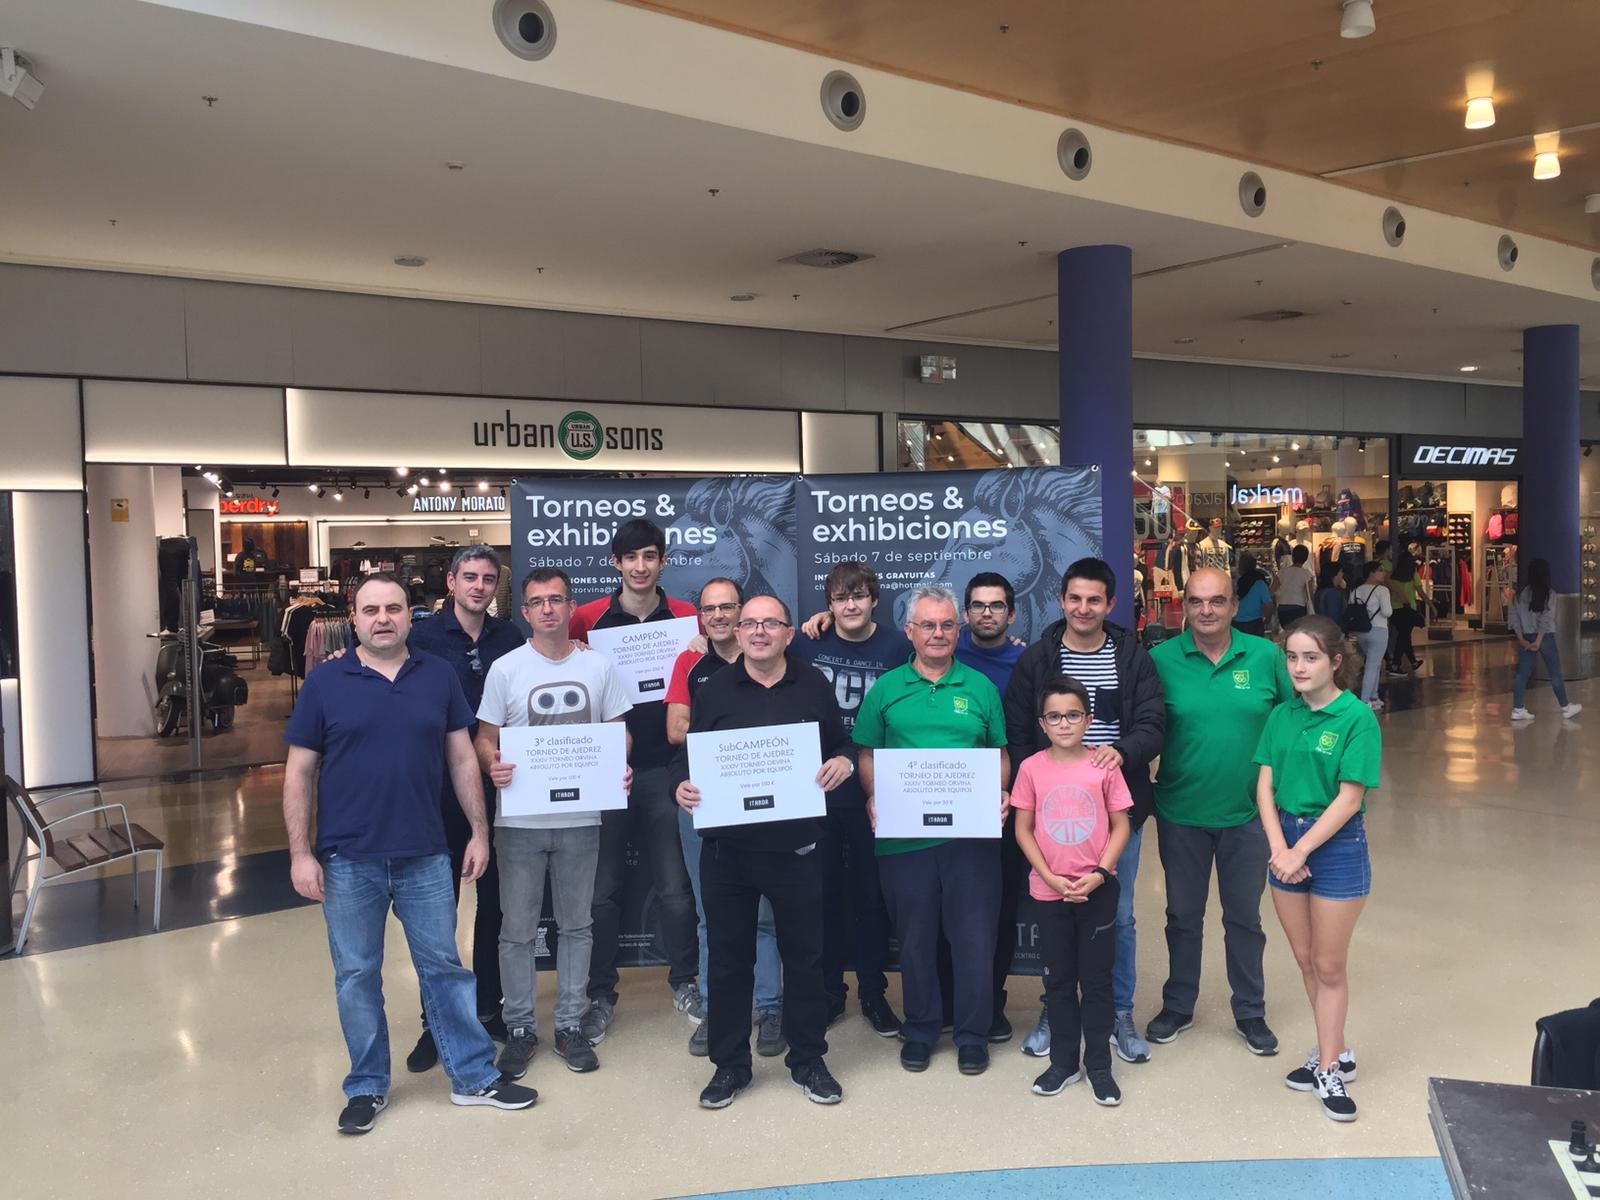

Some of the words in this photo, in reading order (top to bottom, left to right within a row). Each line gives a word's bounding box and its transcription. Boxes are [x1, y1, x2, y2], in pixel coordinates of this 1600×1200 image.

[474, 409, 554, 448] urban
[606, 426, 663, 451] sons
[571, 432, 594, 448] U.S.
[1413, 445, 1518, 465] DECIMAS
[413, 496, 457, 511] ANTONY
[461, 495, 505, 511] MORATO
[525, 495, 647, 518] Torneos
[655, 493, 676, 517] &
[810, 490, 934, 514] Torneos
[943, 486, 964, 510] &
[527, 521, 717, 546] exhibines
[812, 515, 1008, 543] exhibiciones
[529, 555, 582, 568] Sábado
[586, 556, 594, 567] 7
[599, 555, 615, 567] de
[814, 552, 868, 564] Sábado
[871, 552, 880, 562] 7
[885, 551, 903, 562] de
[907, 549, 992, 565] septiembre
[885, 571, 936, 580] GRATUITAS
[622, 630, 667, 644] CAMPEÓN
[612, 644, 641, 654] TORNEO
[652, 638, 679, 648] AJEDREZ
[617, 657, 645, 666] ABSOLUTO
[547, 735, 593, 746] clasificado
[719, 737, 789, 753] SubCAMPEÓN
[525, 748, 558, 757] TORNEO
[560, 747, 569, 755] DE
[571, 745, 602, 754] AJEDREZ
[715, 752, 749, 763] TORNEO
[751, 751, 761, 760] DE
[763, 748, 795, 759] AJEDREZ
[720, 768, 752, 777] ABSOLUTO
[752, 767, 766, 775] POR
[767, 765, 793, 774] EQUIPOS
[740, 760, 766, 769] TORNEO
[767, 758, 791, 766] ORVINA
[920, 760, 967, 770] clasificado
[899, 772, 932, 780] TORNEO
[944, 771, 976, 779] AJEDREZ
